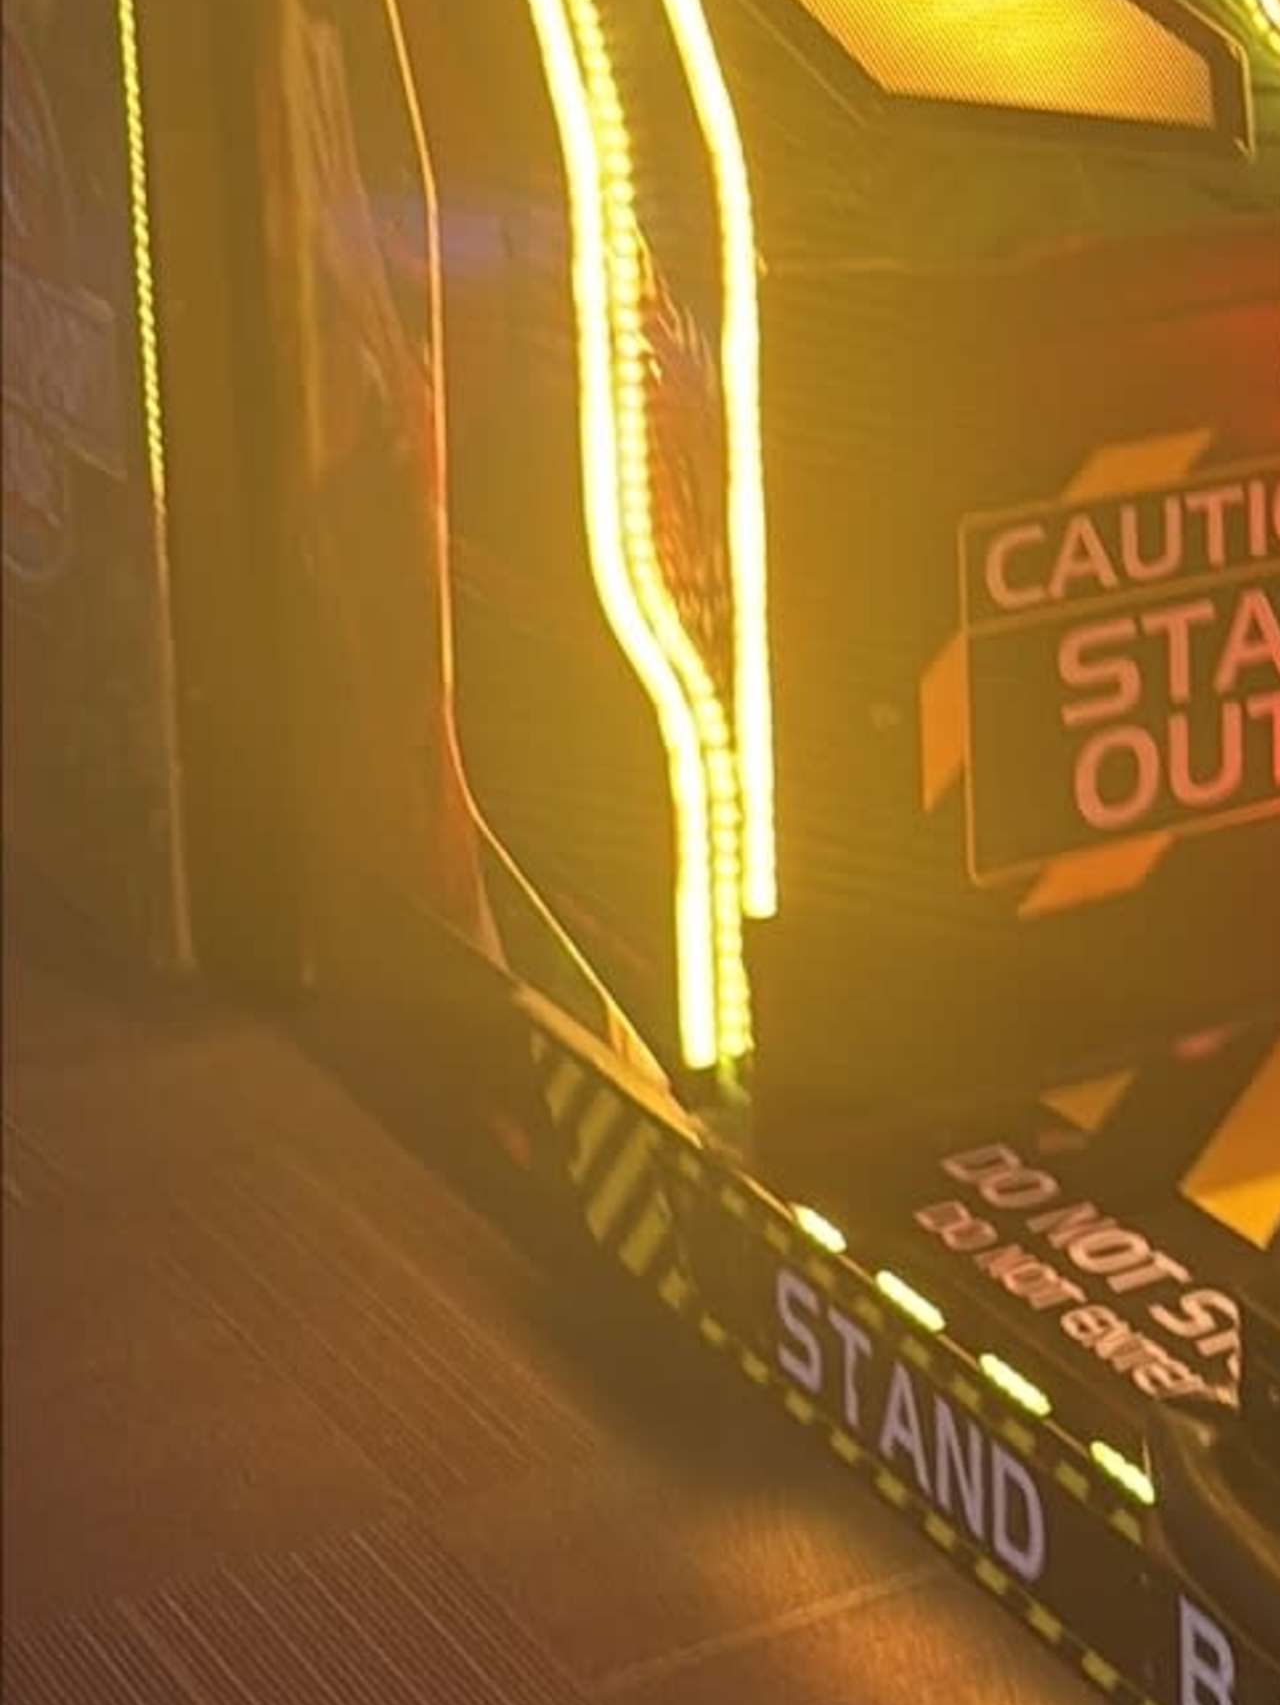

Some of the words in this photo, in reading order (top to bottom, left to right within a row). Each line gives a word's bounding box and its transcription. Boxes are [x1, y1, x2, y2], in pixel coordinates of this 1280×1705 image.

[913, 1200, 997, 1251] DO
[974, 1245, 1087, 1311] NOT
[940, 1142, 1061, 1209] DO
[1025, 1201, 1192, 1293] NOT
[774, 1268, 1045, 1582] STAND
